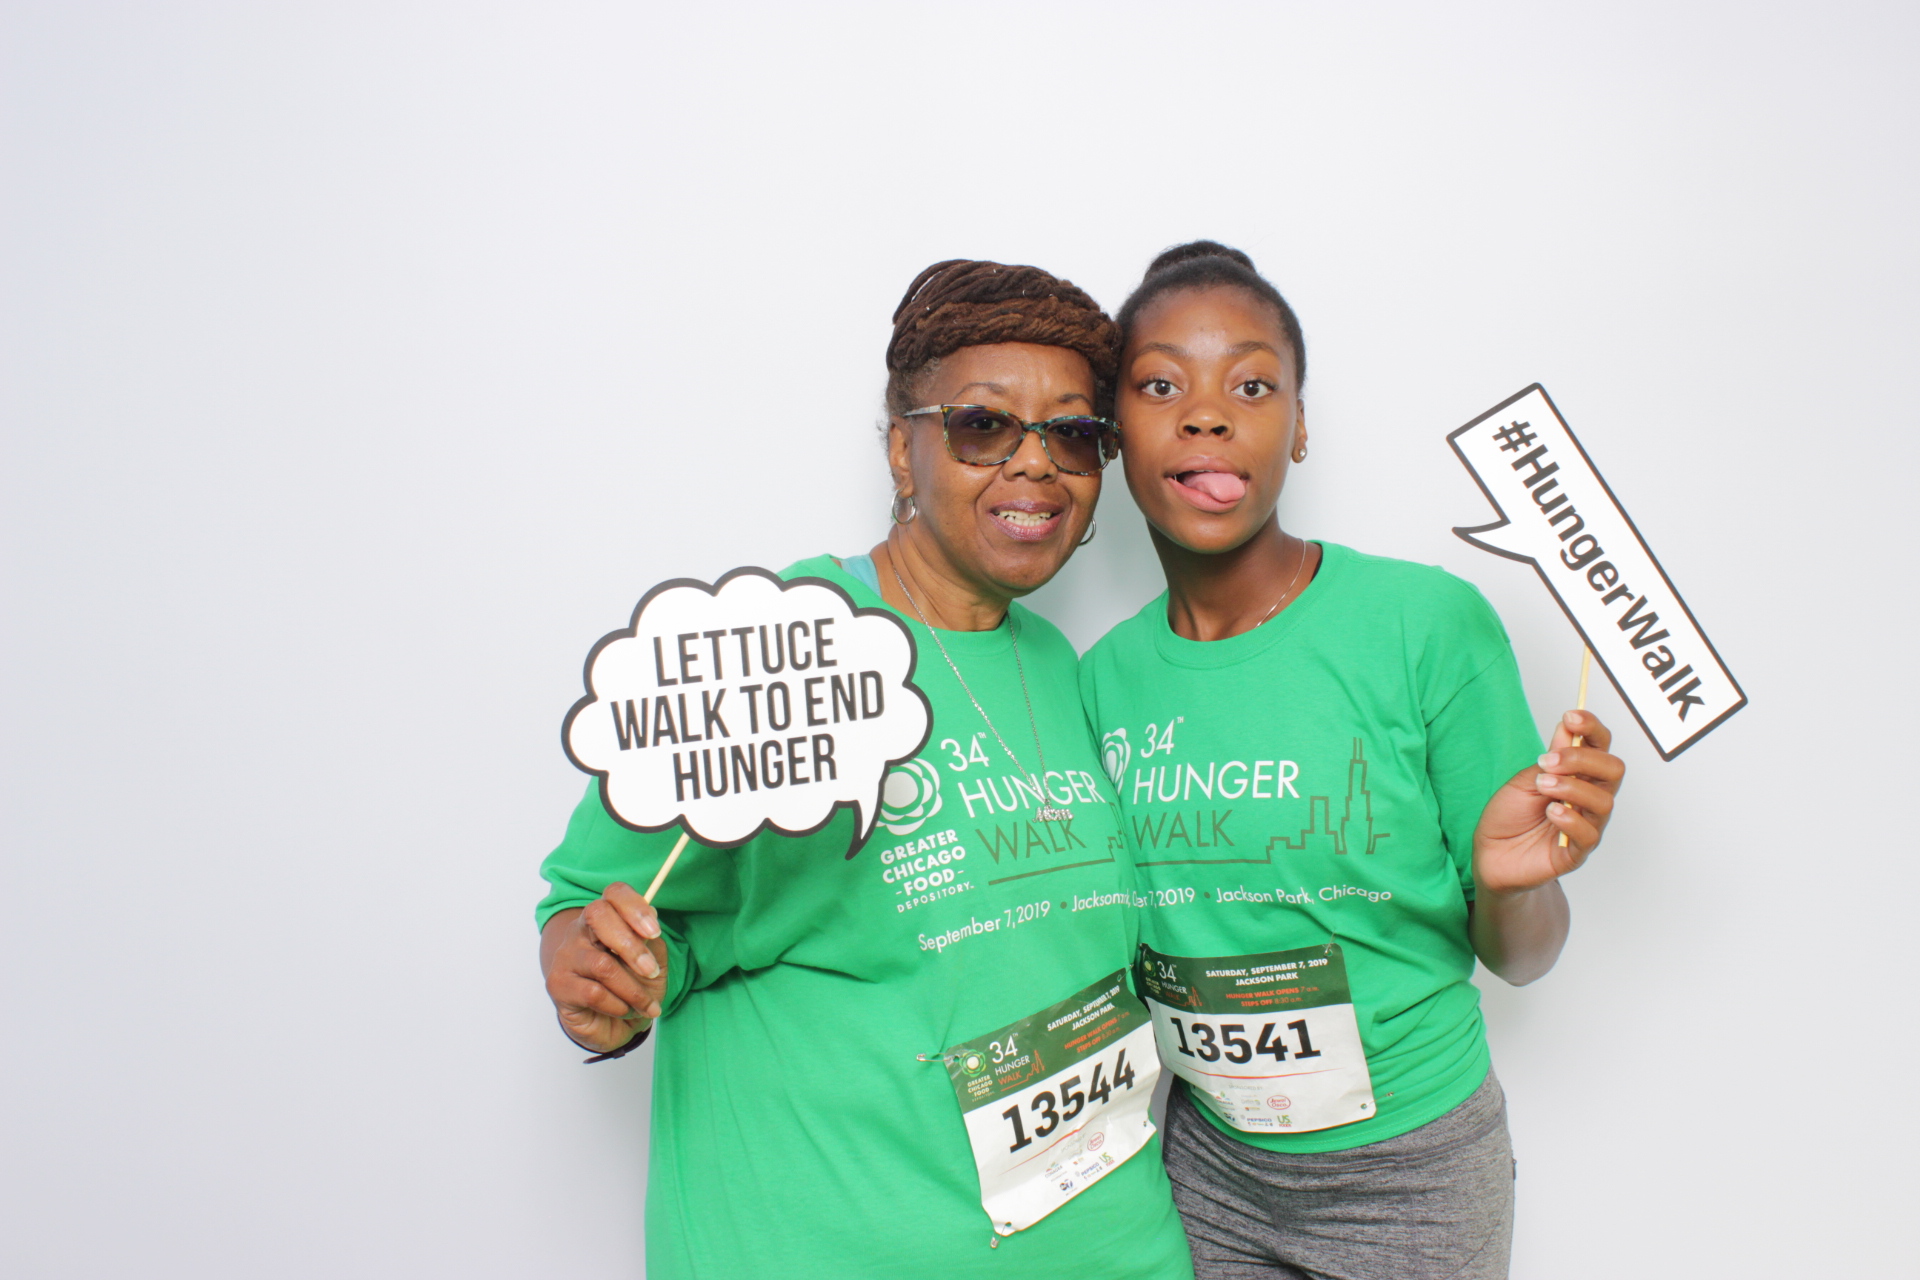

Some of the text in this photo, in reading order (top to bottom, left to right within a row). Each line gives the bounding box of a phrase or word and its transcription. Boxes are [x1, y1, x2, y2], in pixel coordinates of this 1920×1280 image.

[1492, 420, 1706, 723] #HungerWalk
[653, 617, 838, 688] LETTUCE
[610, 670, 886, 751] WALK TO END
[672, 733, 838, 803] HUNGER
[1133, 760, 1301, 805] HUNGER
[957, 769, 1106, 818] HUNGER
[880, 829, 958, 865] GREATER
[975, 814, 1088, 865] WALK
[1131, 809, 1236, 851] WALK
[882, 845, 966, 884] CHICAGO
[1216, 885, 1274, 904] Jackson
[1275, 887, 1315, 905] Park,
[1318, 884, 1392, 903] Chicago
[918, 916, 1001, 953] September
[1205, 968, 1249, 978] SATURDAY,
[1250, 962, 1298, 976] SEPTEMBER
[1307, 958, 1329, 968] 2019
[1235, 971, 1299, 986] JACKSON PARK
[1161, 981, 1188, 995] HUNGER
[1225, 992, 1254, 1000] HUNGER
[1254, 990, 1275, 999] WALK
[1275, 987, 1300, 996] OPENS
[1047, 1009, 1082, 1032] SATURDAY,
[1072, 1002, 1115, 1031] JACKSON PARK
[1170, 1017, 1322, 1064] 13541
[967, 1074, 991, 1088] GREATER
[994, 1055, 1031, 1077] HUNGER
[998, 1071, 1023, 1085] WALK
[967, 1080, 993, 1094] CHICAGO
[1002, 1048, 1135, 1154] 13544
